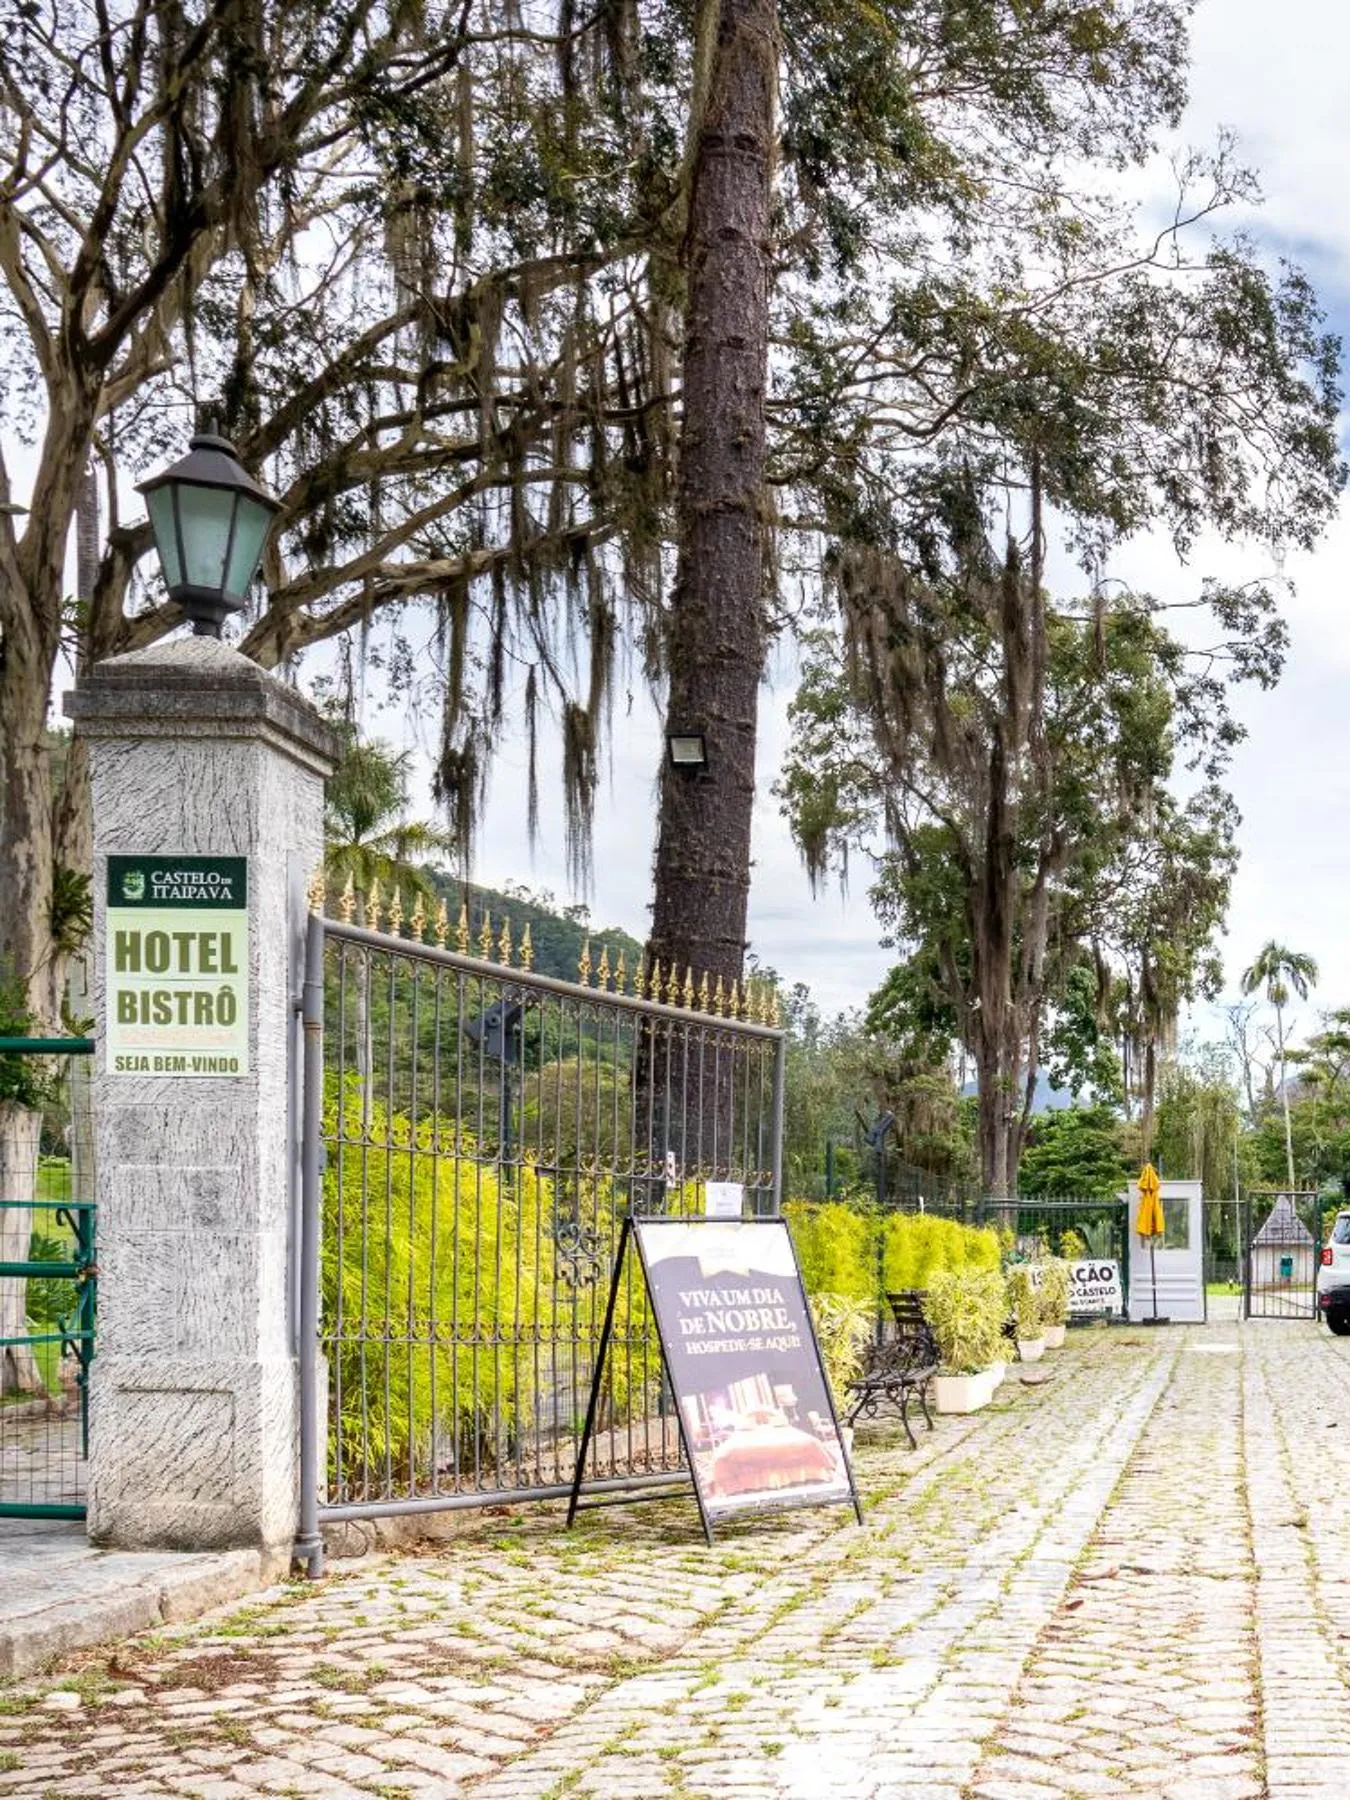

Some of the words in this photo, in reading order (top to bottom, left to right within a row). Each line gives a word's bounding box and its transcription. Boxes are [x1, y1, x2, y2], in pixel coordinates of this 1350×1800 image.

[151, 870, 220, 885] CASTELO
[152, 885, 233, 899] ITAIPAVA
[115, 930, 238, 974] HOTEL
[117, 984, 237, 1026] BISTRÔ
[115, 1055, 149, 1072] SEJA
[154, 1056, 238, 1073] BEM-VINDO
[678, 1290, 720, 1307] VIVA
[720, 1289, 751, 1306] UM
[752, 1288, 785, 1304] DIA
[680, 1317, 706, 1335] DE
[703, 1308, 797, 1333] NOBRE,
